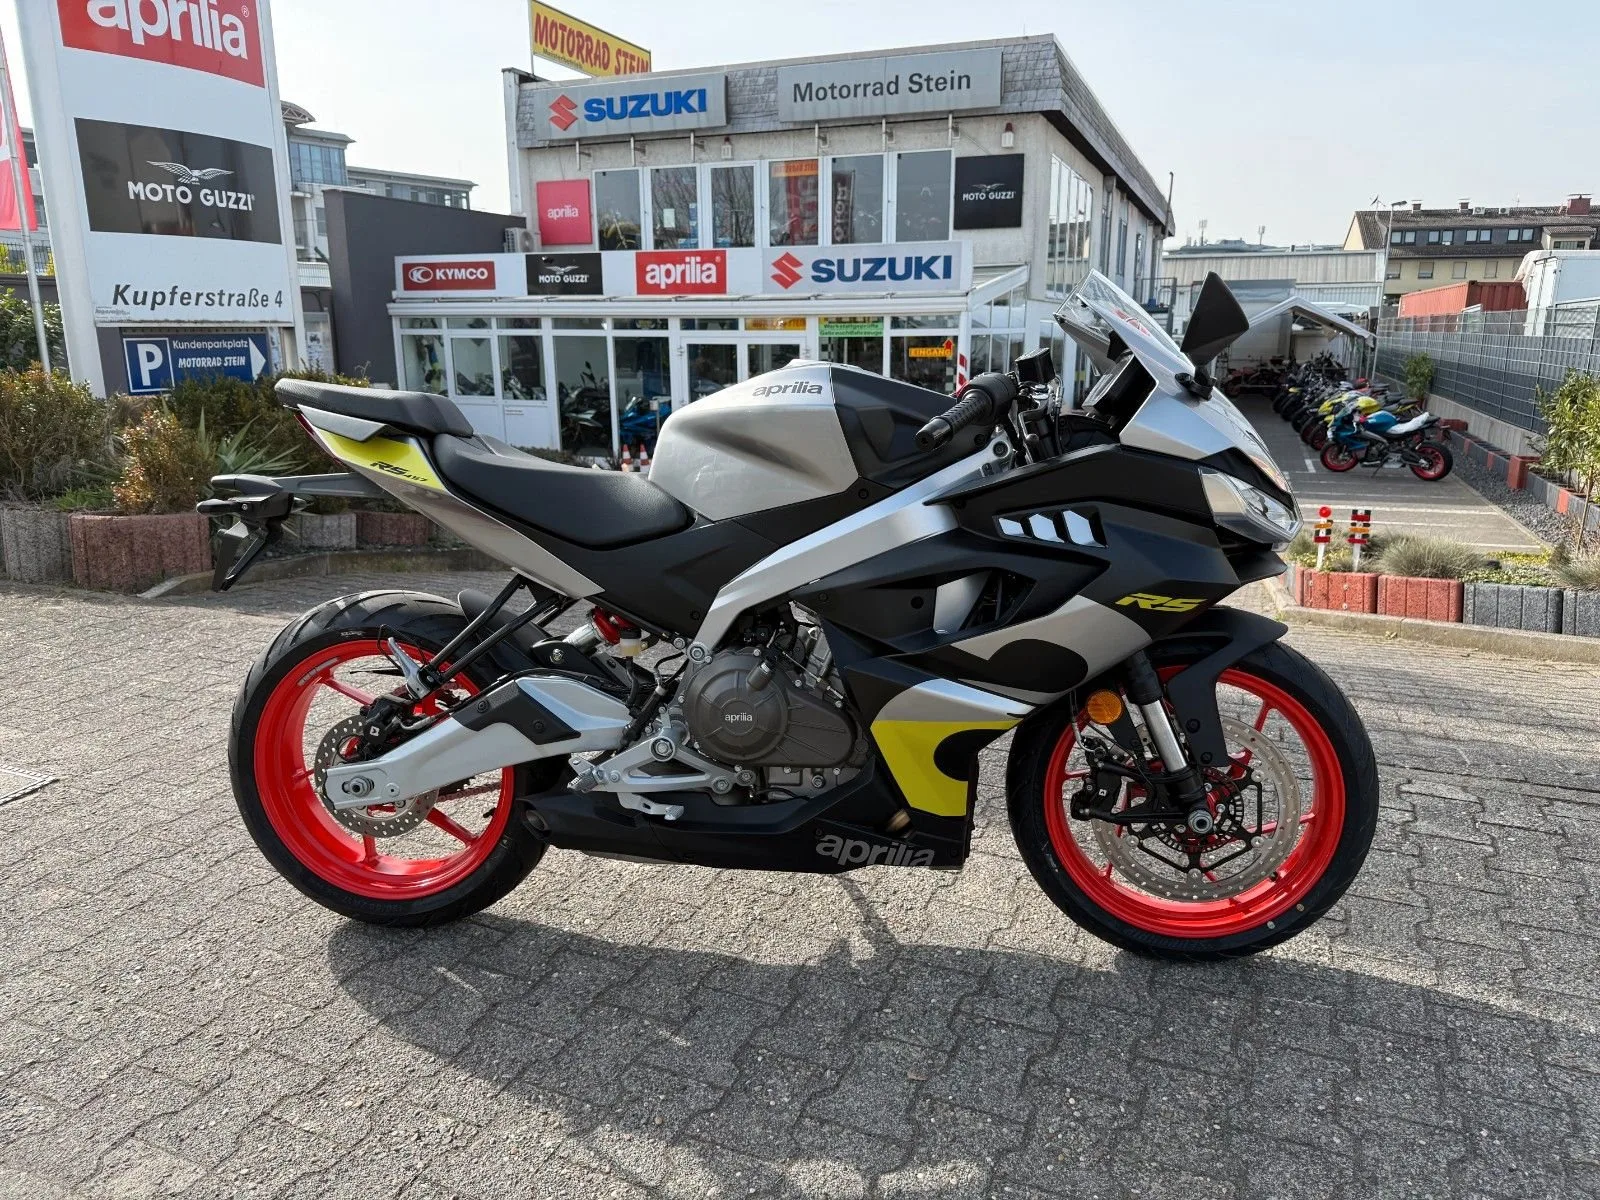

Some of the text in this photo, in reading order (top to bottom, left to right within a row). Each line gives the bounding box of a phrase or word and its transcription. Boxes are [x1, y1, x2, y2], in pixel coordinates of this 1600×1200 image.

[534, 12, 649, 75] MOTORRAD STEIN
[793, 70, 972, 103] Motorrad Stein
[584, 88, 707, 122] SUZUKI
[128, 181, 253, 211] MOTO GUZZI
[962, 191, 1015, 201] MOTO GUZZI
[547, 204, 579, 220] aprilia
[435, 268, 489, 281] KYMCO
[645, 256, 717, 290] aprilia
[811, 255, 952, 283] SUZUKI
[538, 274, 588, 284] MOTO GUZZI
[112, 284, 283, 311] Kupferstraße 4
[173, 339, 249, 351] Kundenparkplatz
[911, 348, 951, 356] EINGANG
[137, 343, 163, 386] P
[178, 356, 246, 368] MOTORRAD STEIN
[752, 381, 823, 398] aprilia
[370, 461, 409, 476] RS
[1115, 593, 1208, 612] RS
[724, 712, 753, 723] aprilia
[815, 833, 936, 867] aprilia
